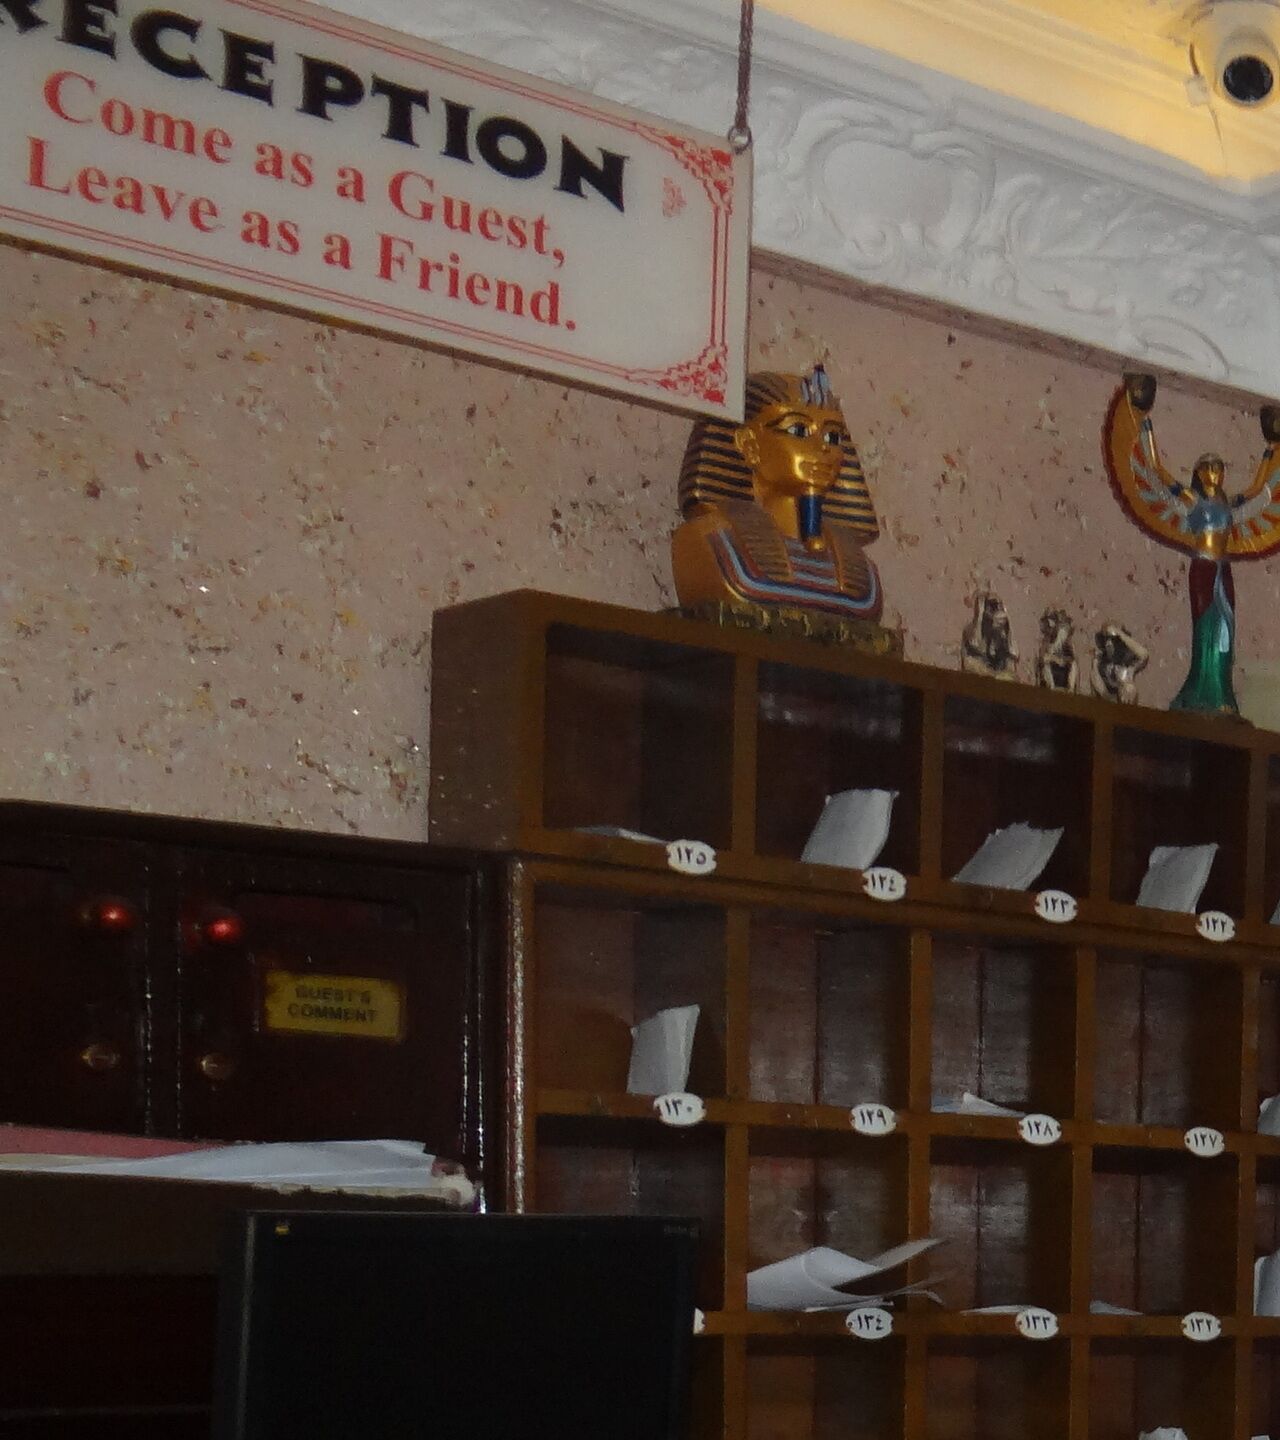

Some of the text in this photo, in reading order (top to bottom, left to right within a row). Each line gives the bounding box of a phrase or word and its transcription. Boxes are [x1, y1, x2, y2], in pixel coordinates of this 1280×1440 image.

[26, 136, 576, 331] Leave as a Friend.
[43, 70, 566, 268] Come as a Guest,
